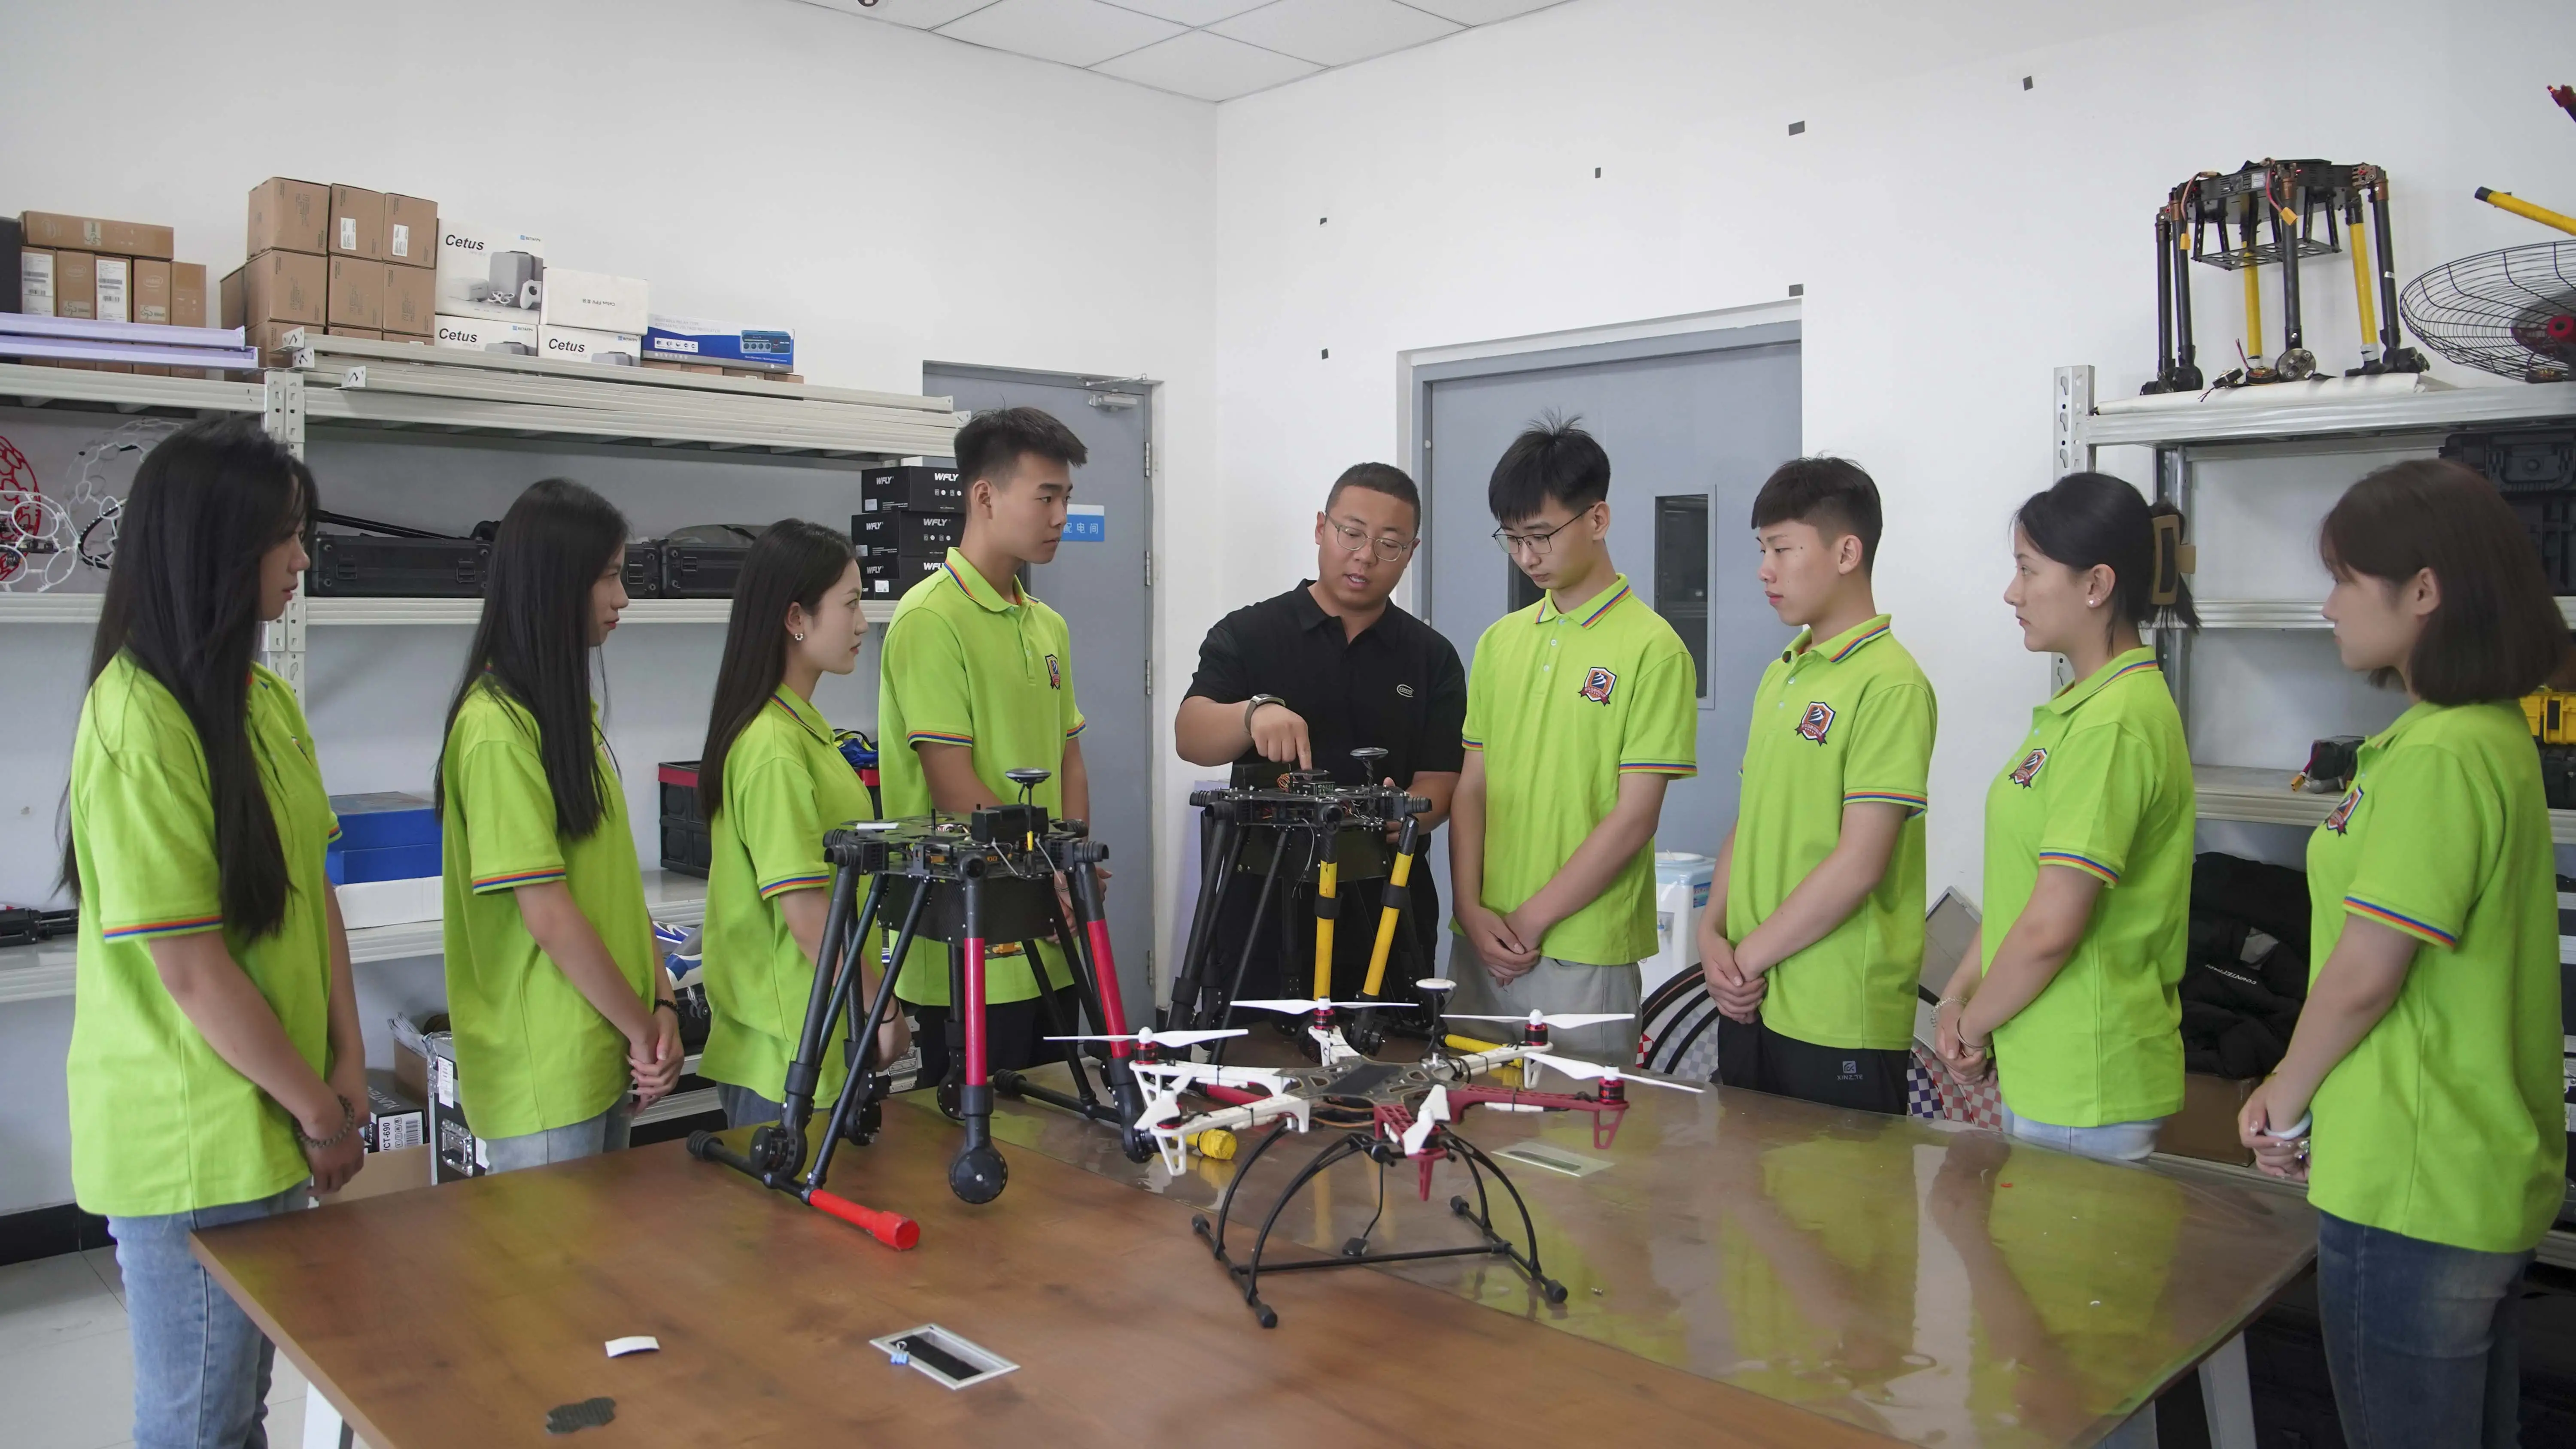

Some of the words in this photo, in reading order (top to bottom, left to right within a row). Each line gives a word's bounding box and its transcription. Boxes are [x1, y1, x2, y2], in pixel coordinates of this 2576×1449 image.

[446, 234, 484, 250] Cetus
[439, 328, 477, 343] Cetus
[549, 338, 585, 352] Cetus
[876, 476, 892, 485] WFLY
[935, 473, 959, 482] WFLY
[866, 522, 882, 530] WFLY
[923, 518, 948, 526] WFLY
[867, 566, 882, 574] WFLY
